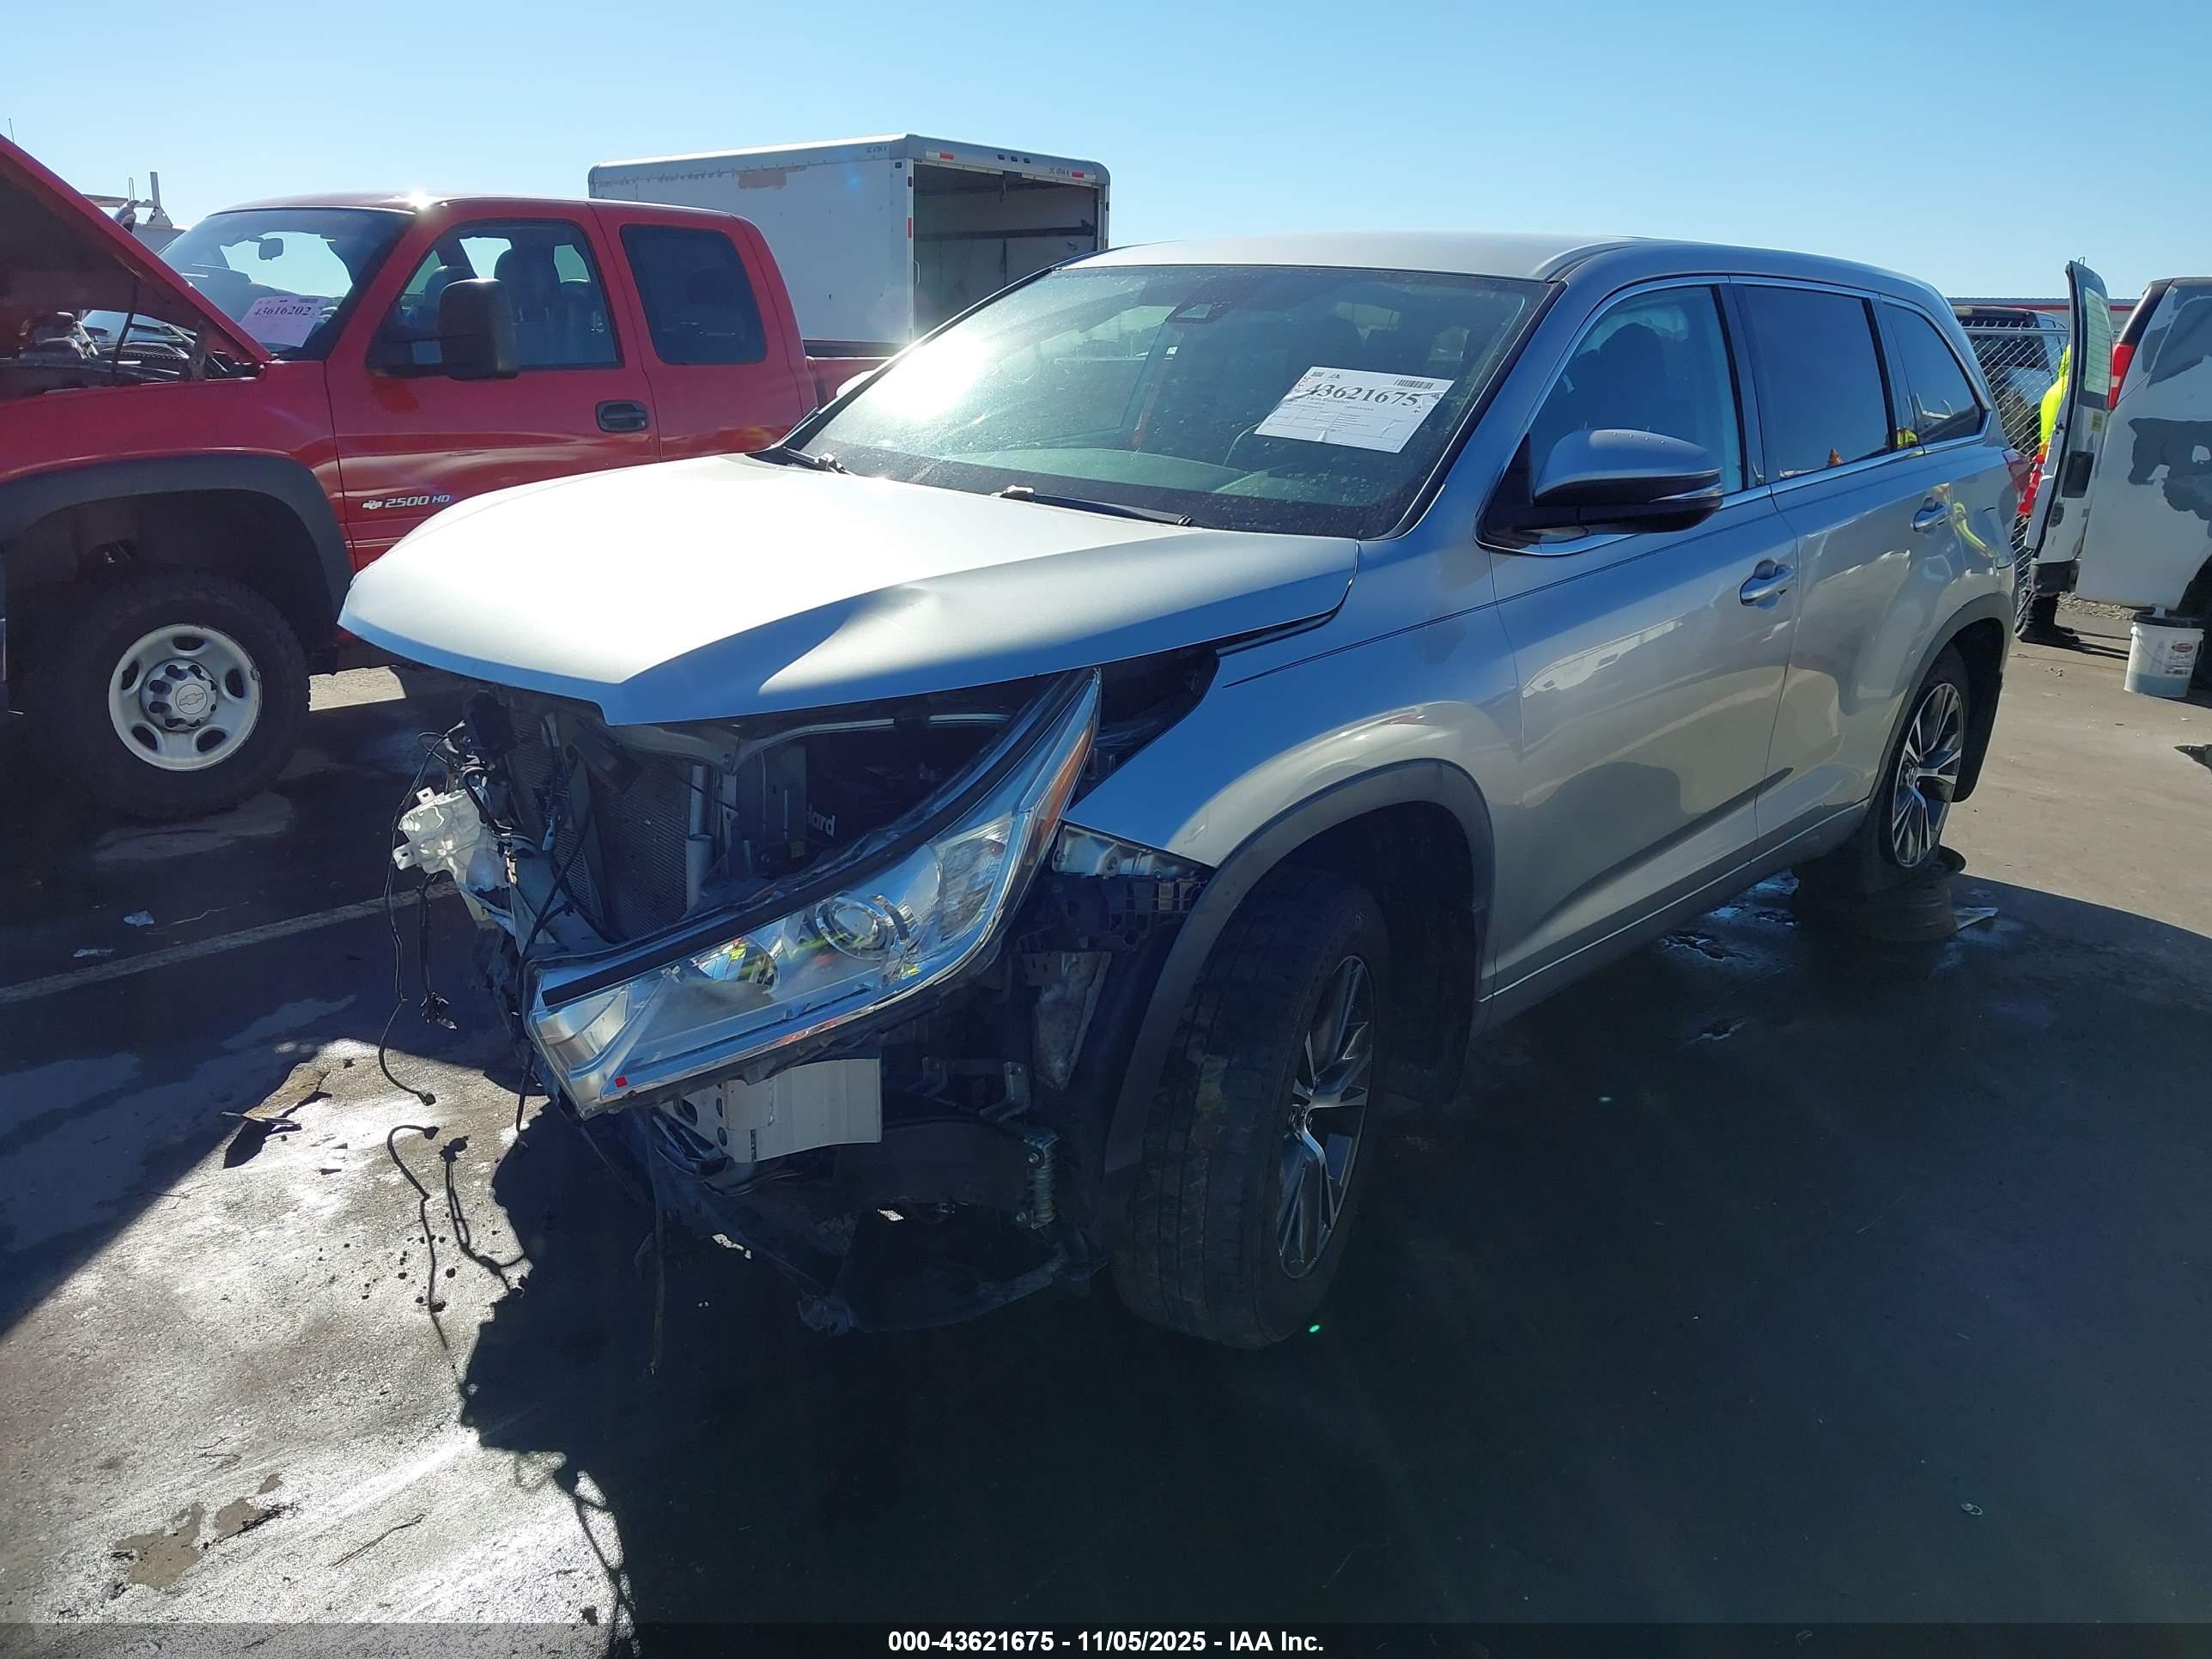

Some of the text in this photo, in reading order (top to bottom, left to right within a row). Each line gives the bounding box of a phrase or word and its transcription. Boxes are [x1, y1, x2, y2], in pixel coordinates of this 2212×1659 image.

[1305, 383, 1423, 407] 43621675
[385, 495, 450, 508] 2500 HD
